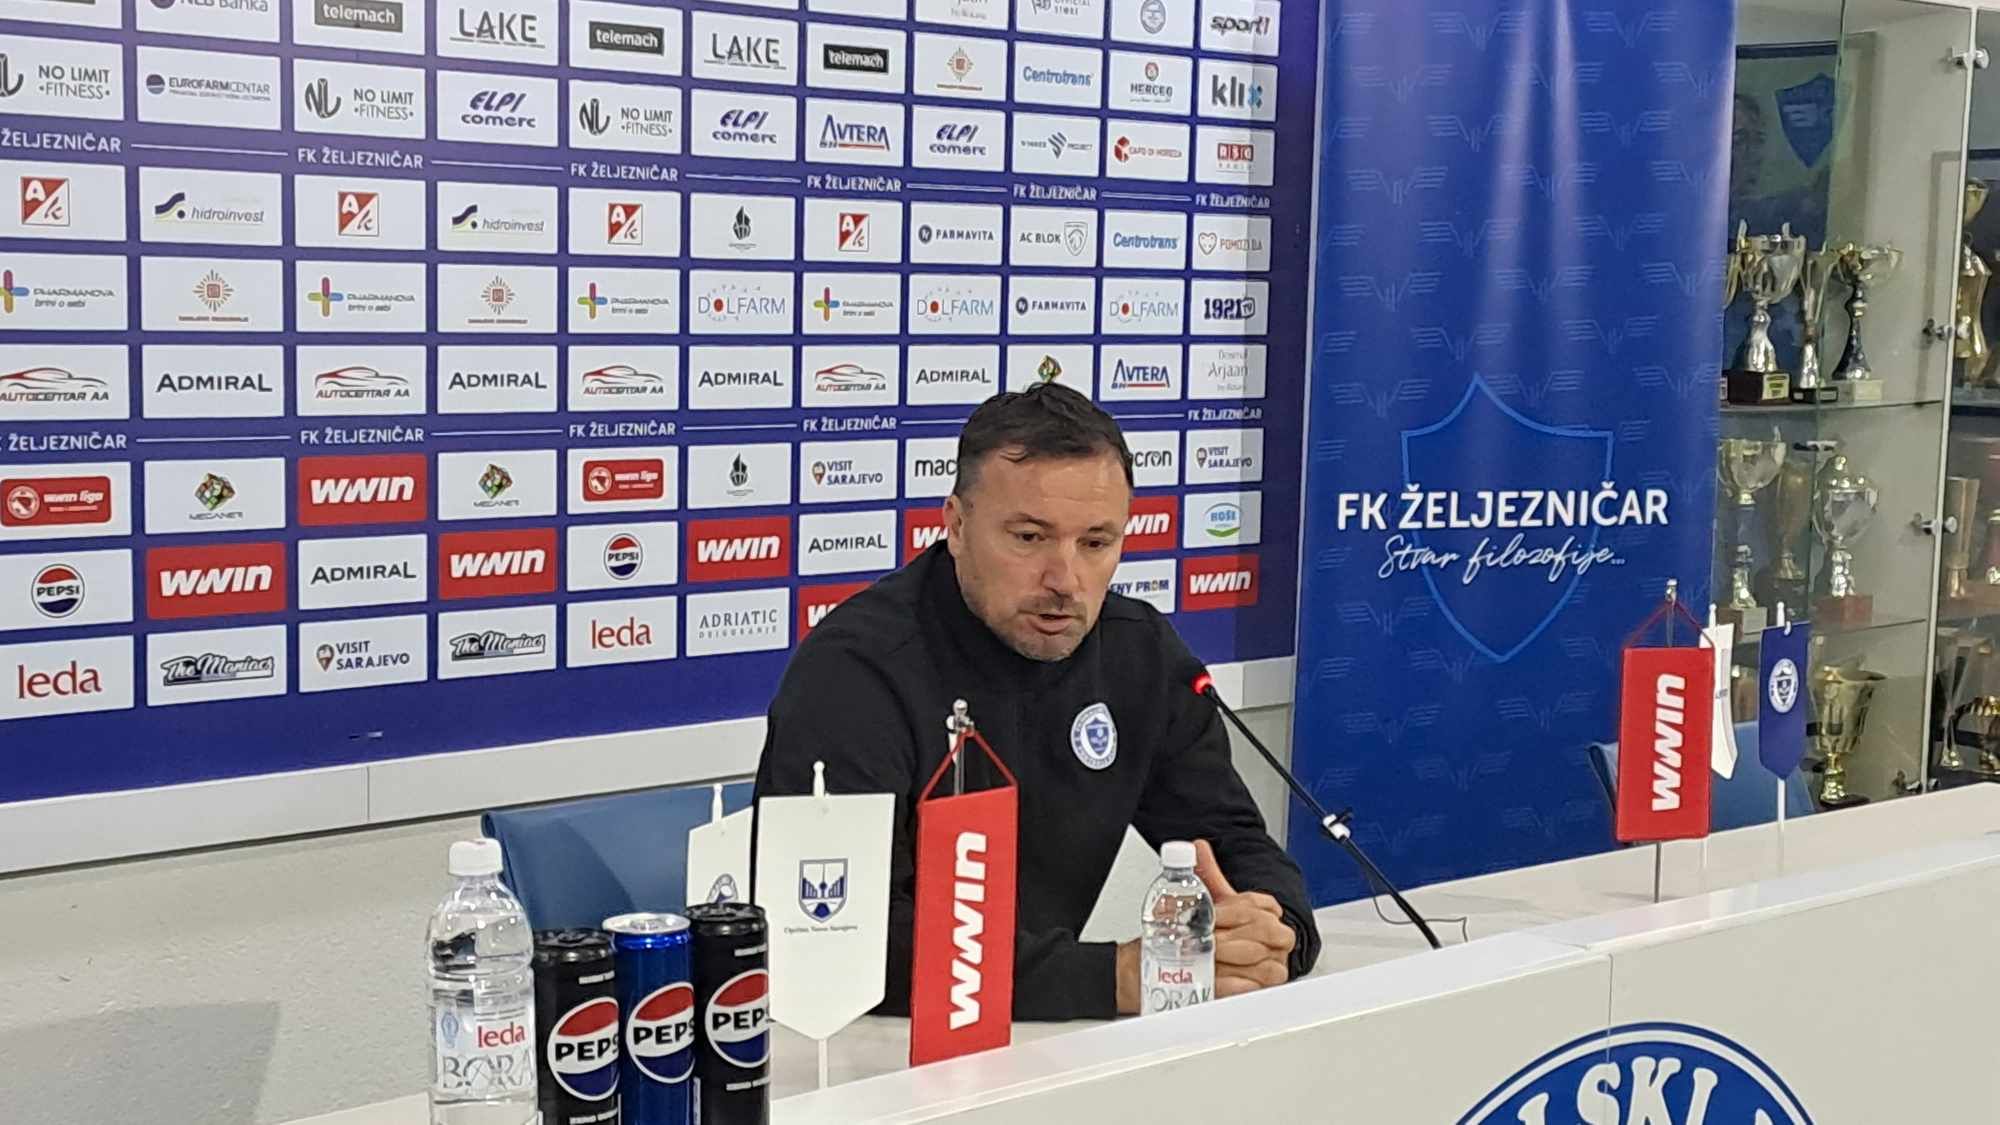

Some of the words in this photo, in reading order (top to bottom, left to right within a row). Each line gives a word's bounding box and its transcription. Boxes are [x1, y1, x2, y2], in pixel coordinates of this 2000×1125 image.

[323, 3, 395, 24] telemach
[458, 7, 538, 43] LAKE
[595, 29, 658, 48] telemach
[712, 33, 780, 64] LAKE
[828, 49, 884, 68] telemach
[39, 65, 65, 80] NO
[71, 67, 110, 83] LIMIT
[1023, 66, 1092, 87] Centrotrans
[354, 88, 376, 102] NO
[381, 91, 414, 105] LIMIT
[470, 90, 527, 113] ELPI
[461, 113, 536, 128] comerc
[621, 107, 640, 121] NO
[644, 109, 673, 124] LIMIT
[720, 109, 769, 129] ELPI
[1, 128, 121, 153] ŽELJEZNIČAR
[712, 129, 777, 144] comerc
[298, 147, 316, 163] FK
[322, 147, 423, 169] ŽELJEZNIČAR
[929, 143, 986, 156] comerc
[571, 163, 587, 178] FK
[591, 161, 678, 182] ŽELJEZNIČAR
[807, 175, 822, 189] FK
[825, 173, 901, 193] ŽELJEZNIČAR
[1014, 184, 1027, 198] FK
[1196, 194, 1207, 206] FK
[190, 205, 264, 223] hidroinvest
[482, 217, 544, 233] hidroinvest
[936, 231, 994, 241] FARMAVITA
[1020, 233, 1031, 243] AC
[1036, 234, 1061, 244] BLOK
[1113, 232, 1178, 250] Centrotrans
[156, 373, 272, 392] ADMIRAL
[448, 371, 547, 390] ADMIRAL
[698, 370, 784, 387] ADMIRAL
[915, 367, 991, 384] ADMIRAL
[0, 392, 86, 401] AUTOCENTAR
[91, 391, 109, 401] AA
[394, 389, 410, 398] AA
[650, 385, 664, 394] AA
[804, 419, 818, 431] FK
[821, 415, 897, 431] ŽELJEZNIČAR
[1188, 409, 1200, 421] FK
[301, 430, 319, 444] FK
[325, 426, 424, 444] ŽELJEZNIČAR
[569, 424, 585, 437] FK
[590, 420, 676, 437] ŽELJEZNIČAR
[8, 432, 127, 450] ŽELJEZNIČAR
[1134, 450, 1172, 467] cron
[1208, 446, 1229, 457] VISIT
[827, 460, 852, 472] VISIT
[914, 459, 957, 477] mac
[1208, 457, 1252, 469] SARAJEVO
[827, 473, 883, 486] SARAJEVO
[1337, 493, 1387, 530] FK
[1399, 481, 1668, 528] ŽELJEZNIČAR
[808, 534, 888, 554] ADMIRAL
[607, 552, 639, 563] PEPSI
[1378, 534, 1459, 579] Stvar
[310, 561, 416, 585] ADMIRAL
[36, 584, 80, 597] PEPSI
[700, 609, 777, 629] ADRIATIC
[591, 617, 652, 649] leda
[336, 641, 370, 655] VISIT
[450, 633, 483, 657] The
[161, 657, 200, 683] The
[336, 653, 410, 671] SARAJEVO
[18, 660, 102, 699] leda
[1158, 965, 1193, 985] leda
[477, 1022, 526, 1049] leda
